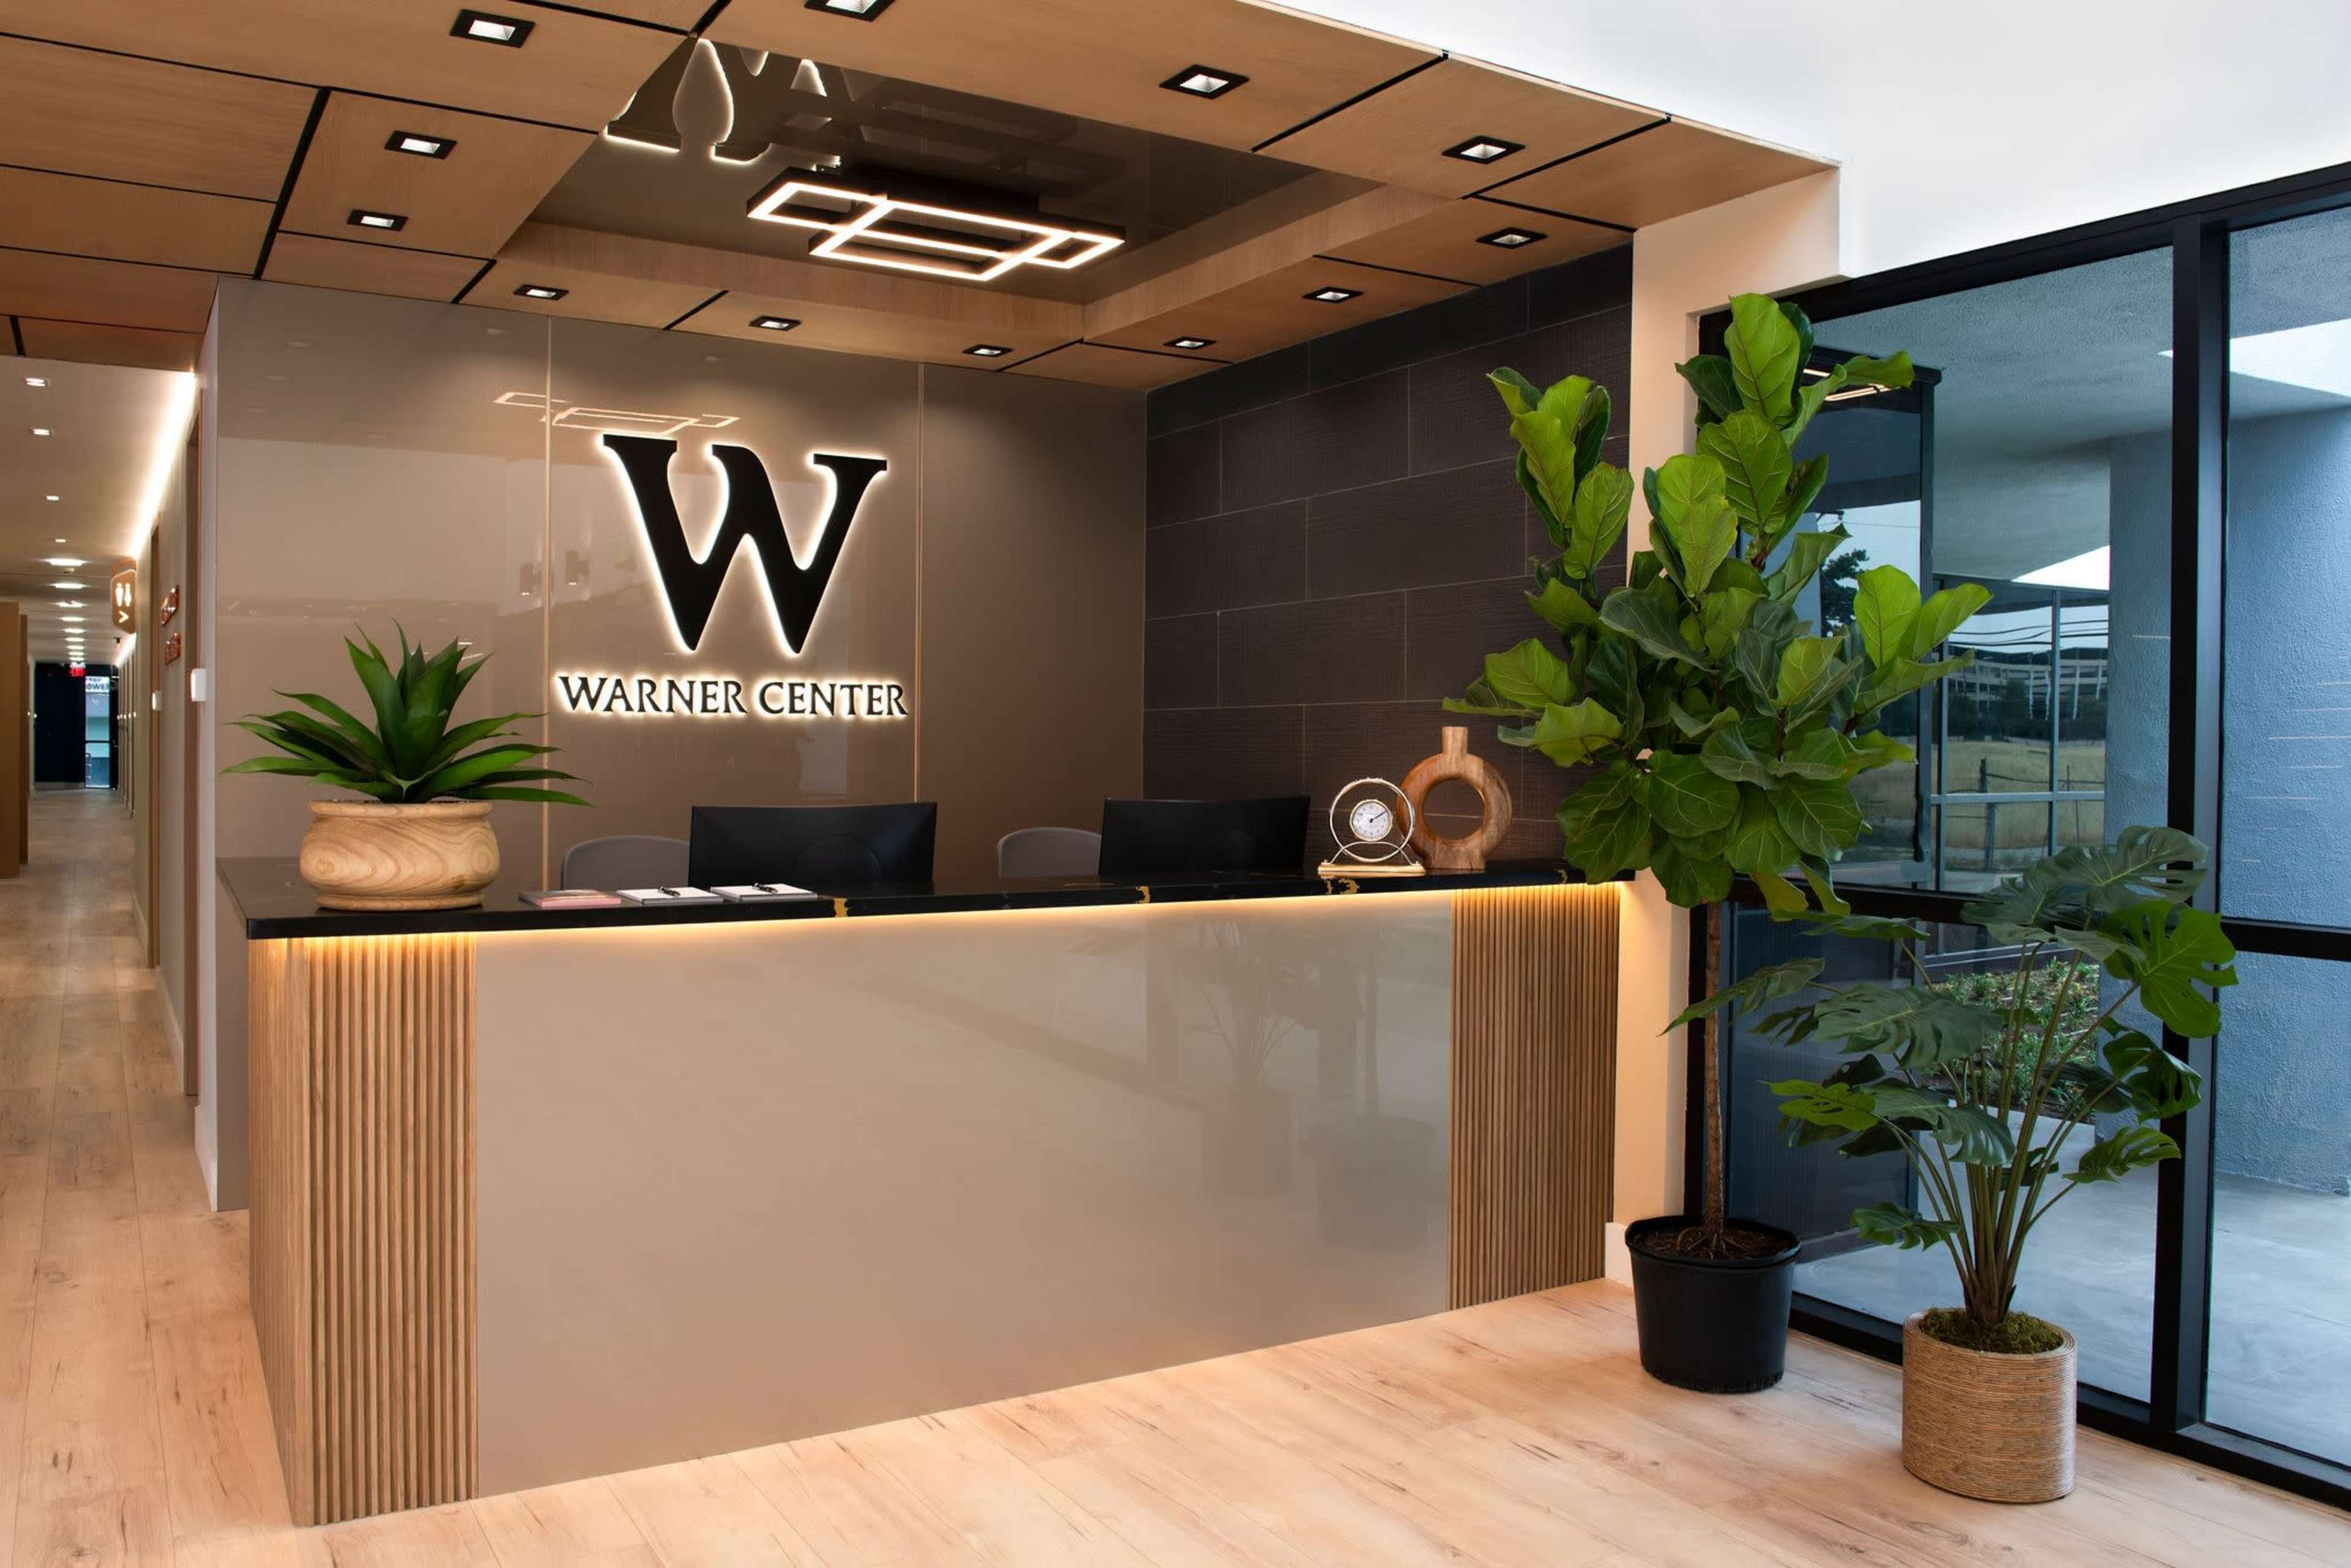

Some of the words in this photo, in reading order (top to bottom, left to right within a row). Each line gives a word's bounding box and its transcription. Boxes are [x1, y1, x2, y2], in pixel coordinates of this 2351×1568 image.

[602, 433, 888, 654] W
[558, 676, 748, 714] WARNER
[759, 681, 909, 716] CENTER
